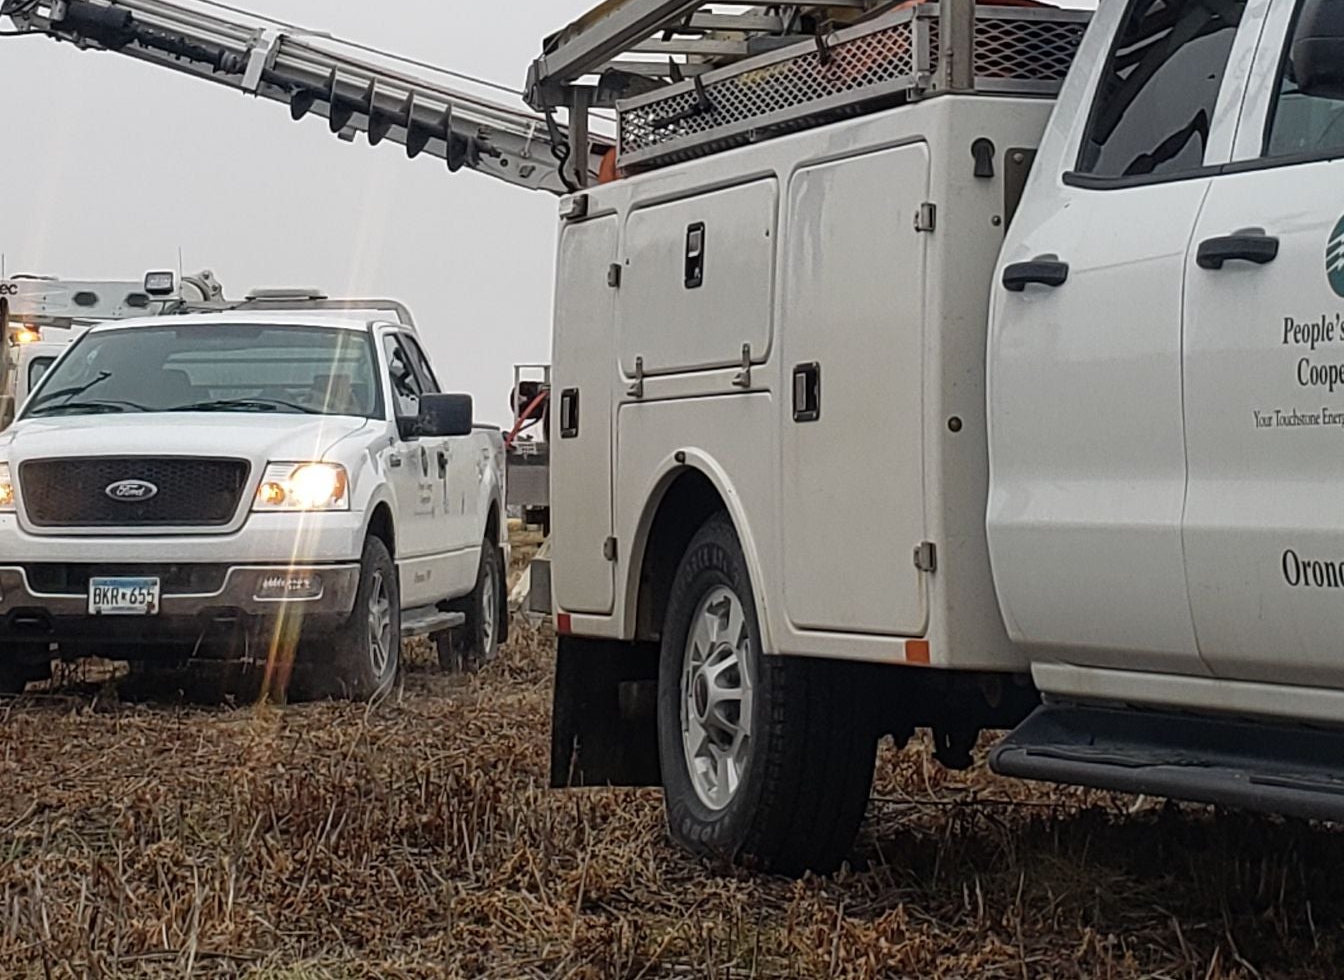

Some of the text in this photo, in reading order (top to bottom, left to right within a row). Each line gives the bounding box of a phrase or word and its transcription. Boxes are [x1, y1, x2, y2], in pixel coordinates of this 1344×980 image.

[1253, 409, 1273, 428] Your
[1274, 407, 1321, 427] Touchstone
[93, 587, 155, 605] BKR 655
